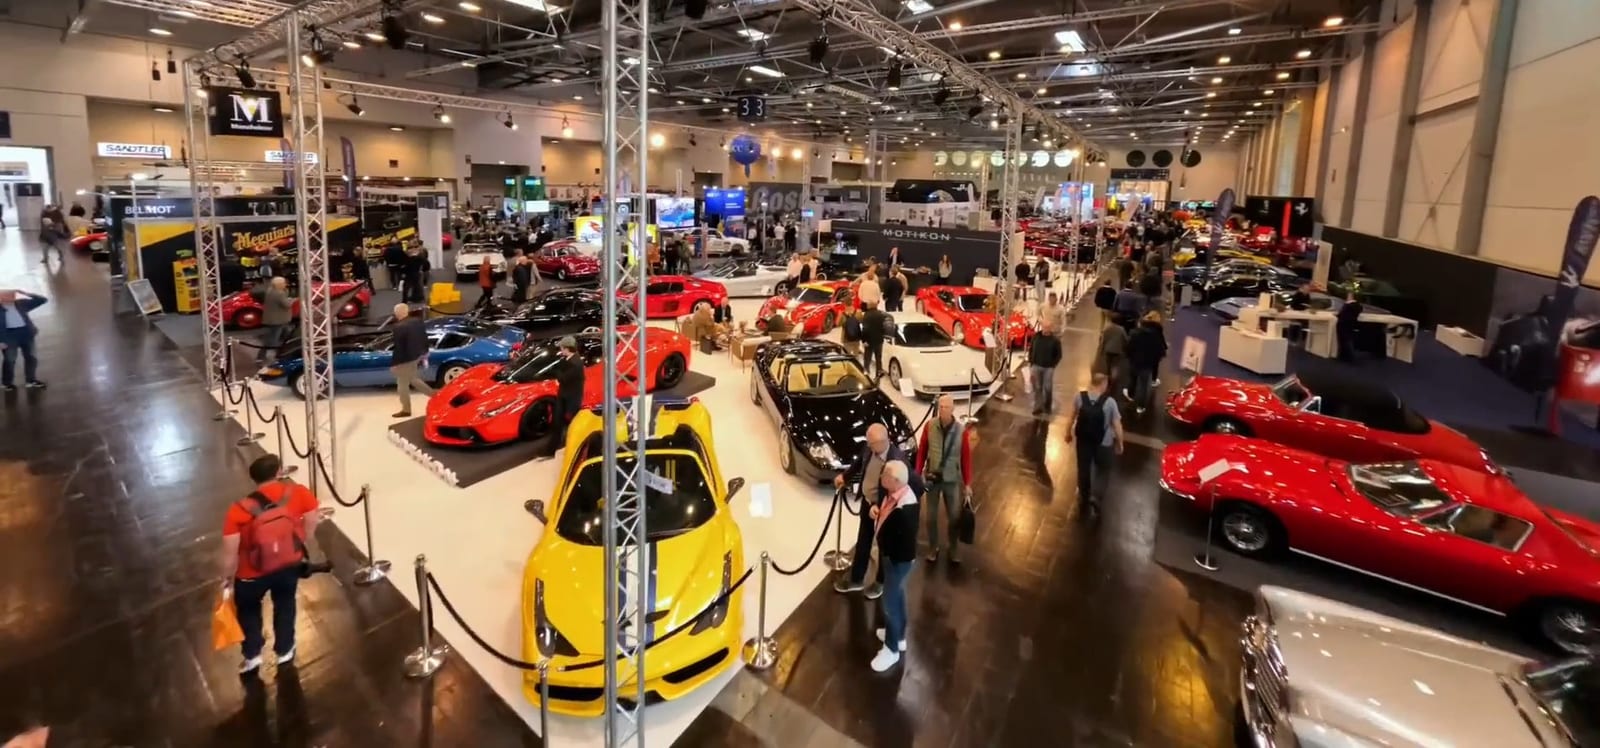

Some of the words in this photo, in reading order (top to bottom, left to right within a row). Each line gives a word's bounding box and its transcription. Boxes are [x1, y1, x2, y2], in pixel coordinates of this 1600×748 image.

[228, 94, 272, 123] M
[741, 98, 749, 115] 3
[756, 99, 763, 116] 3
[105, 144, 166, 153] SANDTLER
[882, 229, 950, 241] MOTIKON
